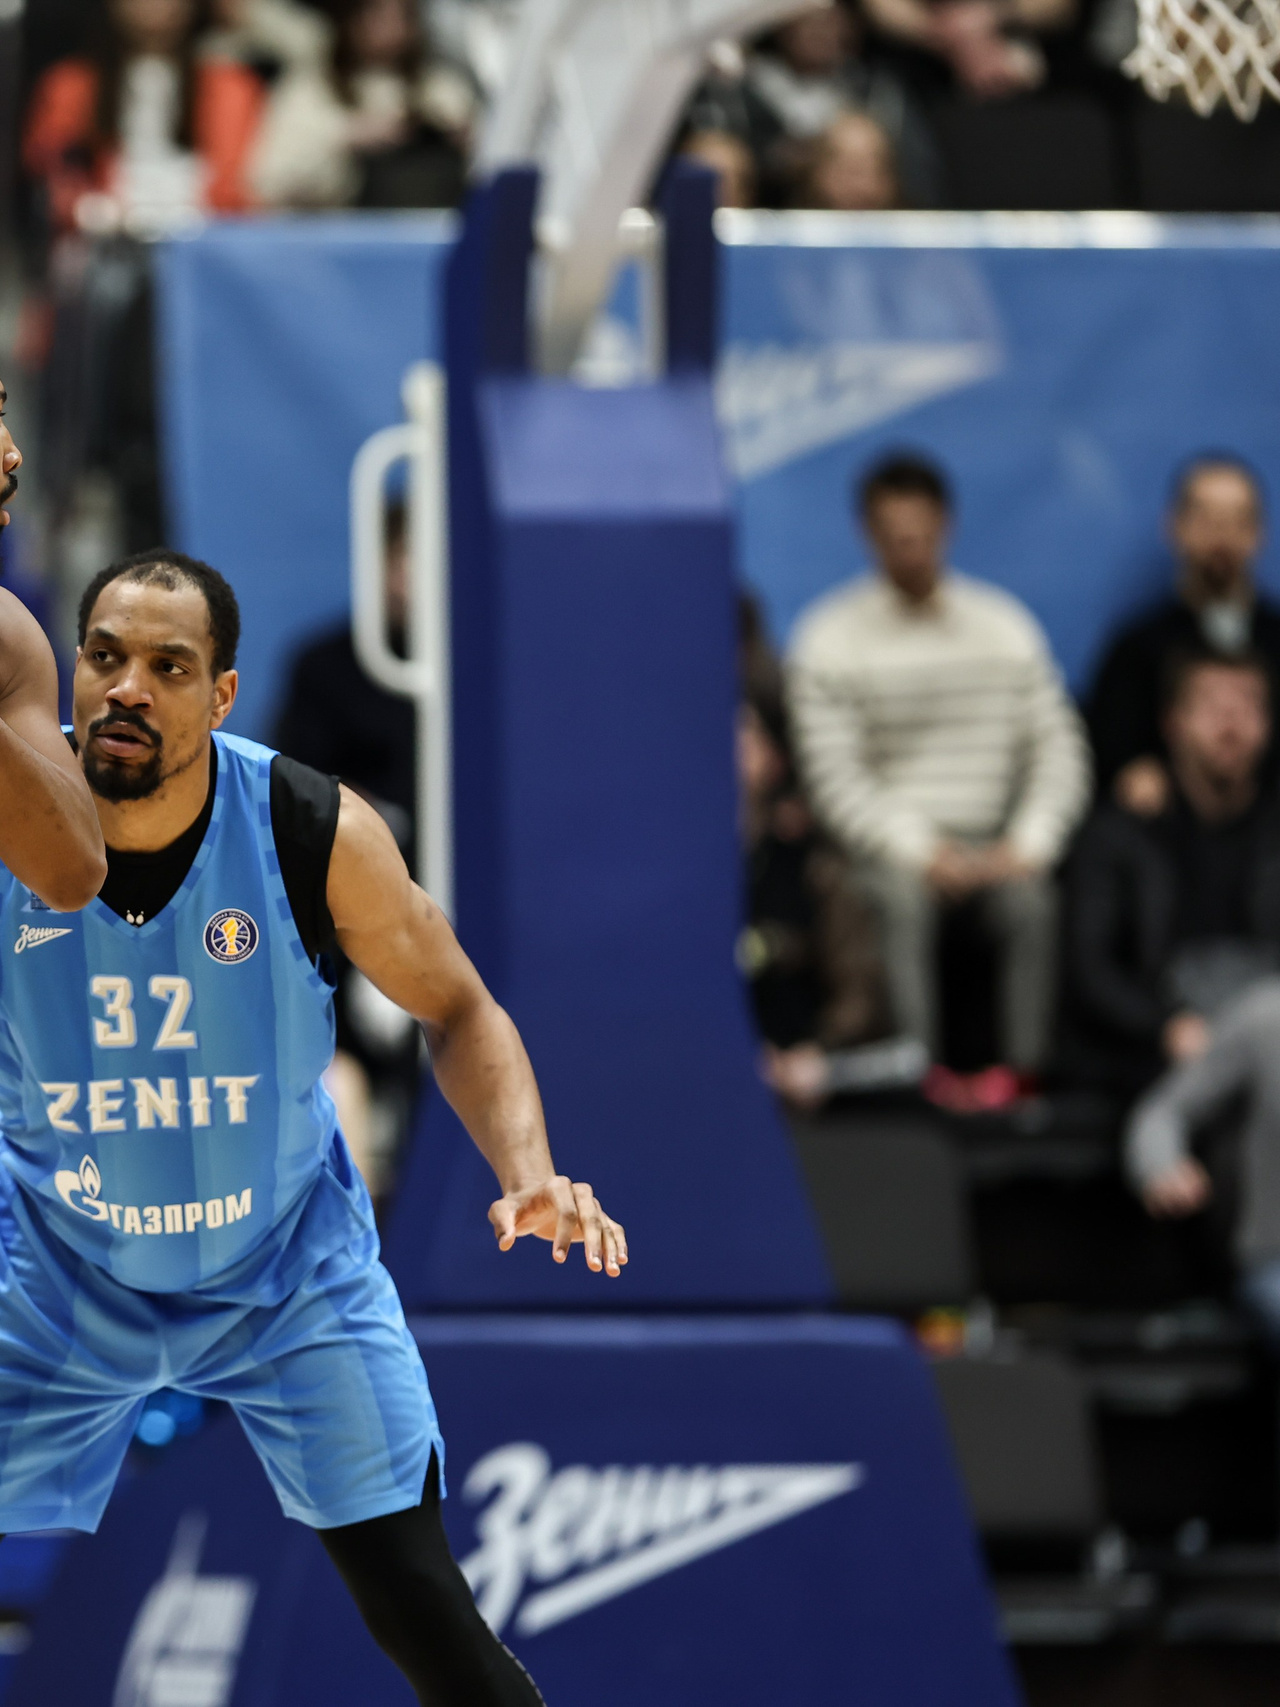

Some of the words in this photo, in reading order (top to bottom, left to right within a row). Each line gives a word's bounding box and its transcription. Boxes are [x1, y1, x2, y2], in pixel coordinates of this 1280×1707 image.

[90, 975, 198, 1050] 32
[40, 1074, 263, 1135] ZENIT
[109, 1187, 253, 1236] ГАЗПРОМ
